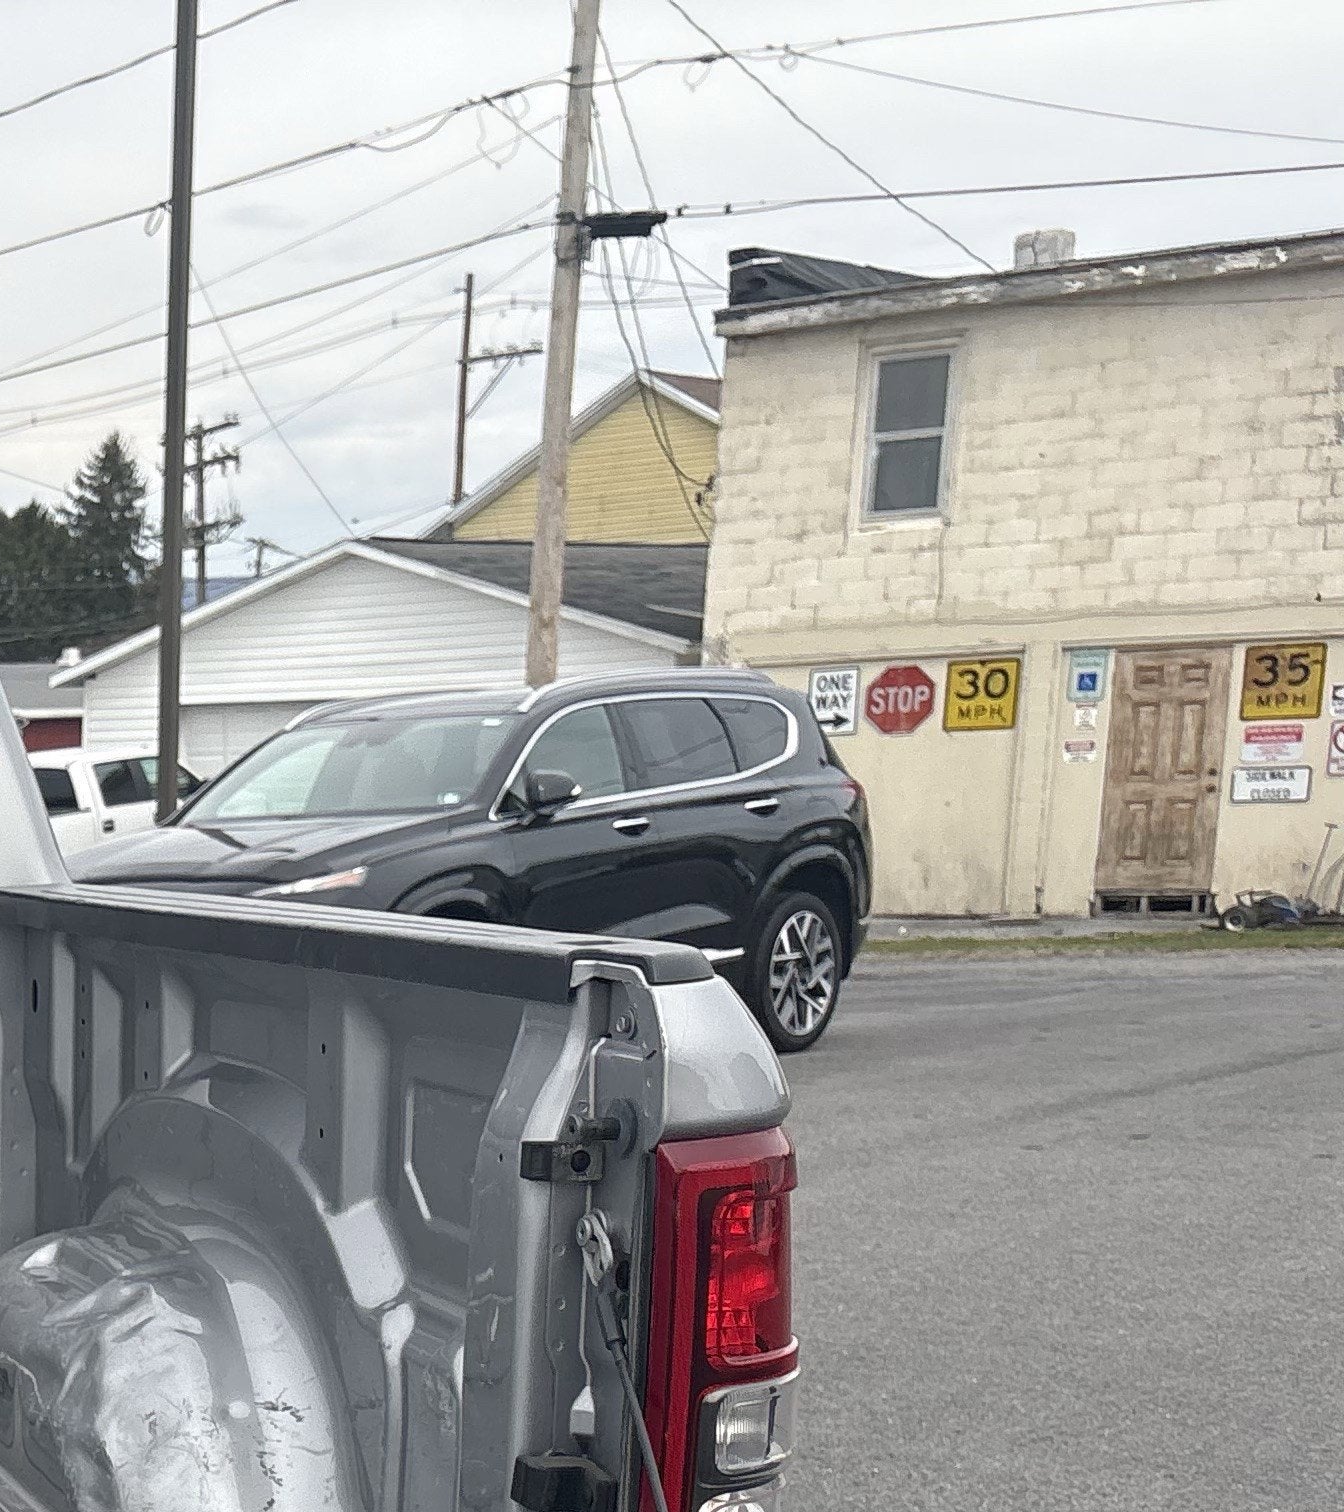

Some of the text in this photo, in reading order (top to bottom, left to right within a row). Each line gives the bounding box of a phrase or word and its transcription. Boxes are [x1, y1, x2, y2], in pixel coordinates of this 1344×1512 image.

[1252, 652, 1310, 688] 35
[815, 673, 853, 693] ONE
[955, 668, 1010, 700] 30
[815, 693, 853, 709] WAY
[869, 684, 931, 716] STOP
[1256, 692, 1307, 709] MPH
[957, 704, 1006, 721] MPH
